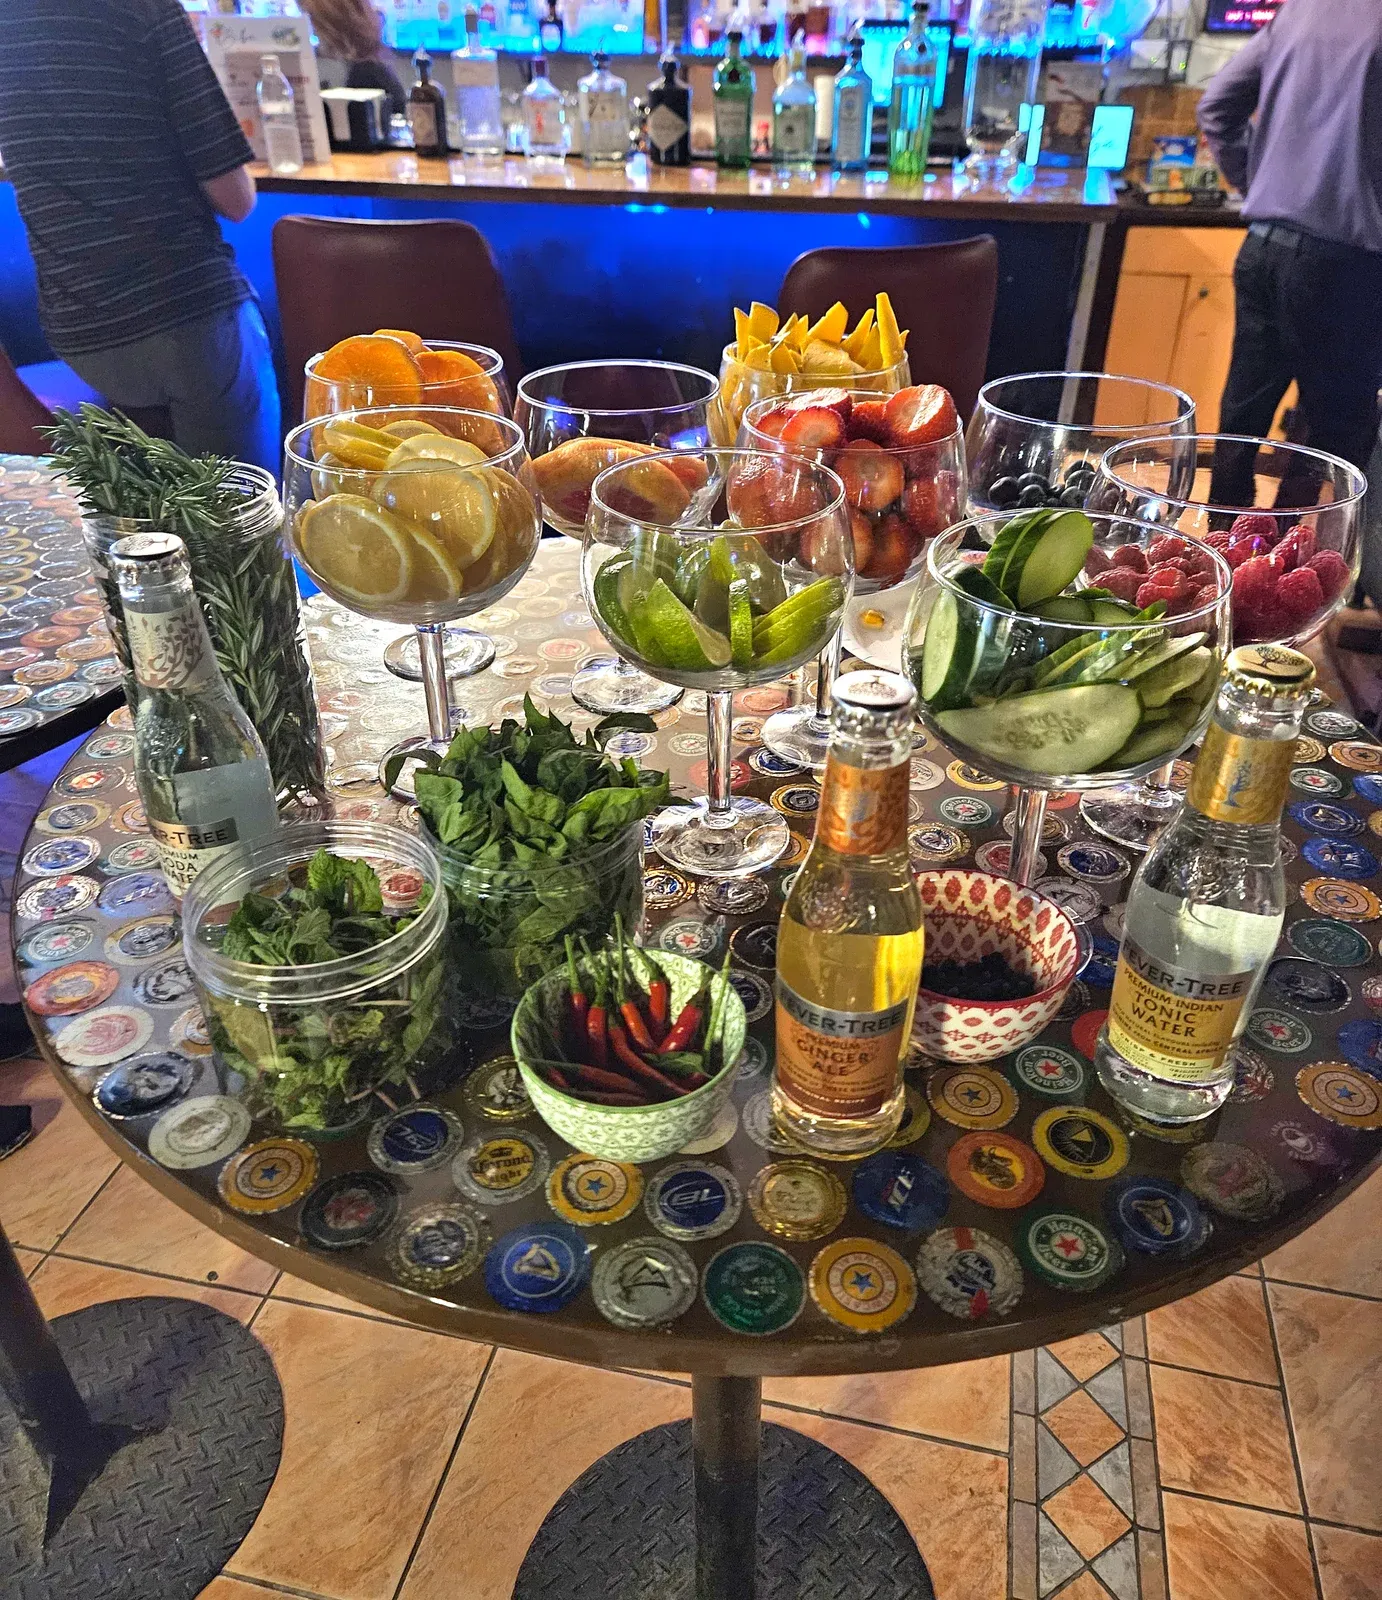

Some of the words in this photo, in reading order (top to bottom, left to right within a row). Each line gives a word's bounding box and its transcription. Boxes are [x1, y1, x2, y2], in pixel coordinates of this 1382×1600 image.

[163, 866, 194, 884] WATE
[1124, 967, 1172, 1005] PREMIUM
[1175, 998, 1225, 1013] INDIAN
[1131, 1002, 1197, 1038] WATER
[1135, 990, 1197, 1025] TONIC
[796, 1038, 870, 1064] GINGER
[1160, 1057, 1197, 1067] FRESH
[811, 1060, 850, 1077] ALE
